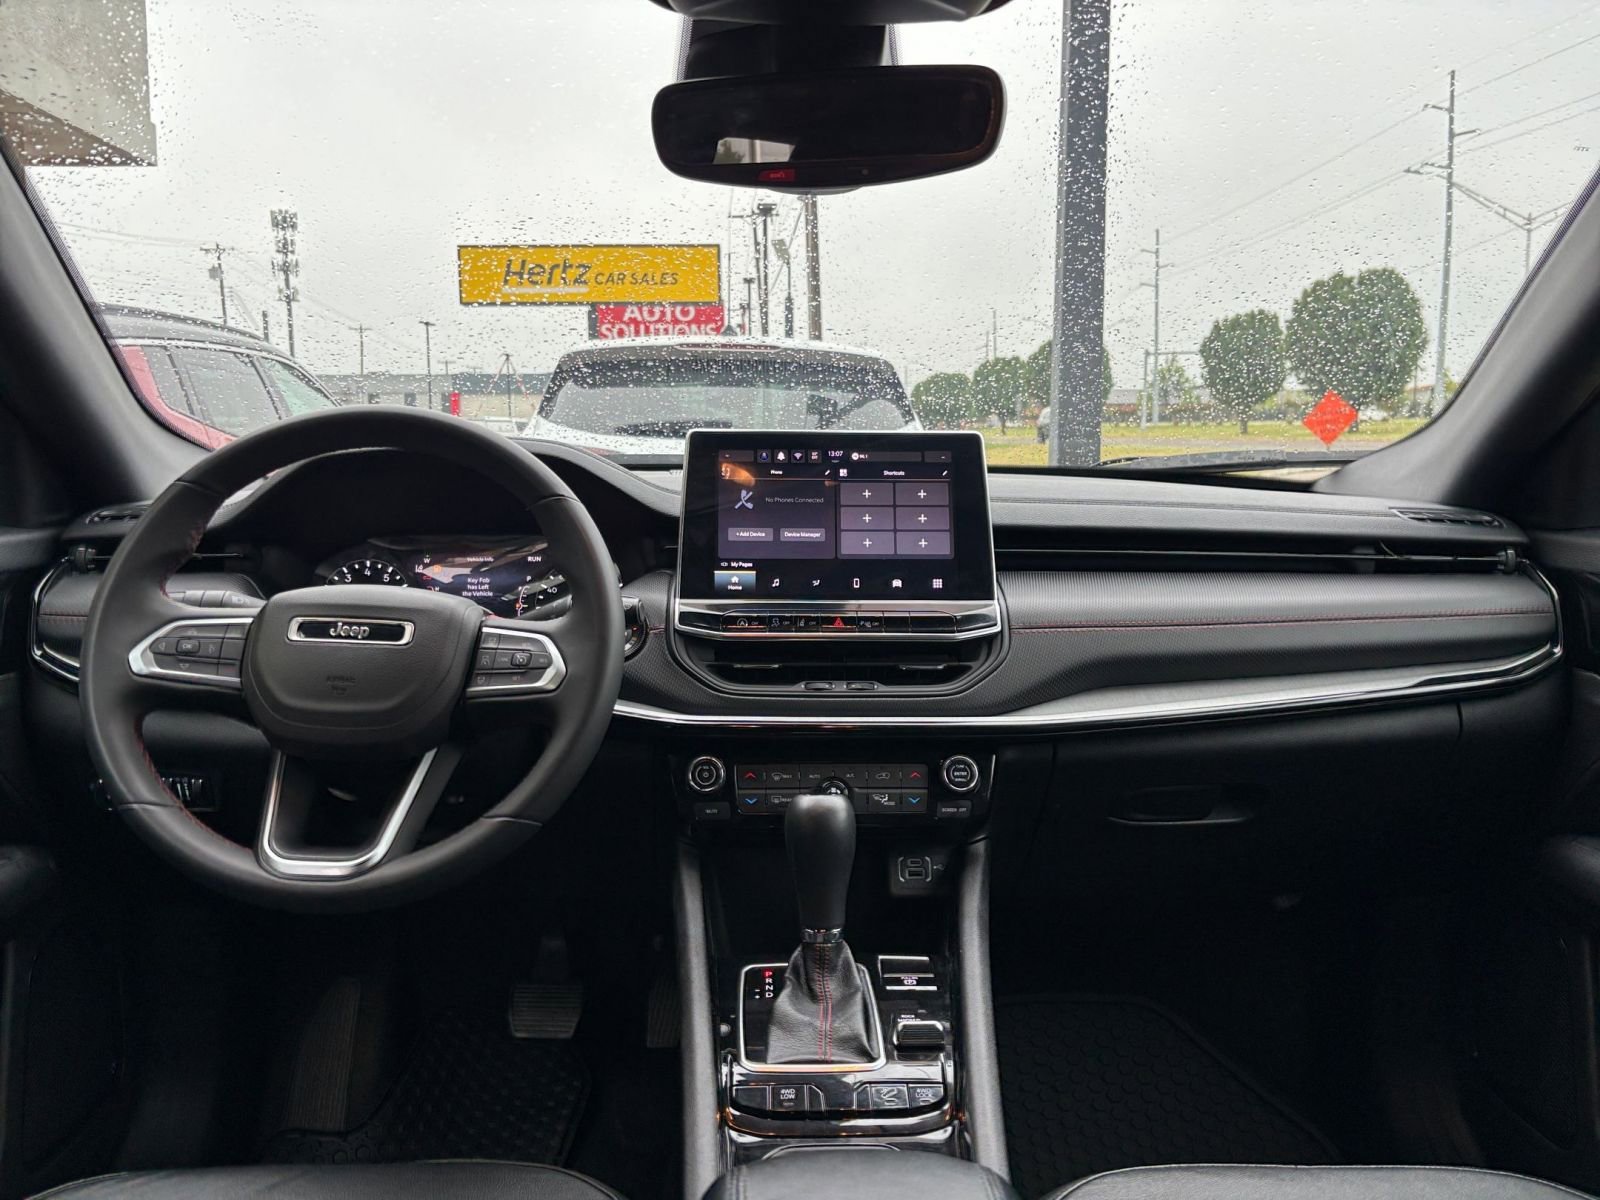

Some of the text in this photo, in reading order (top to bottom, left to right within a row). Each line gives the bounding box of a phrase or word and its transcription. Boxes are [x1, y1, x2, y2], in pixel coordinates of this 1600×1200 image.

[503, 258, 679, 286] Hertz CAR SALES
[623, 305, 696, 321] AUTO
[600, 323, 718, 340] SOLUTIONS
[345, 573, 352, 583] 3
[364, 567, 371, 576] 4
[383, 573, 390, 582] 5
[329, 622, 370, 639] Jeep
